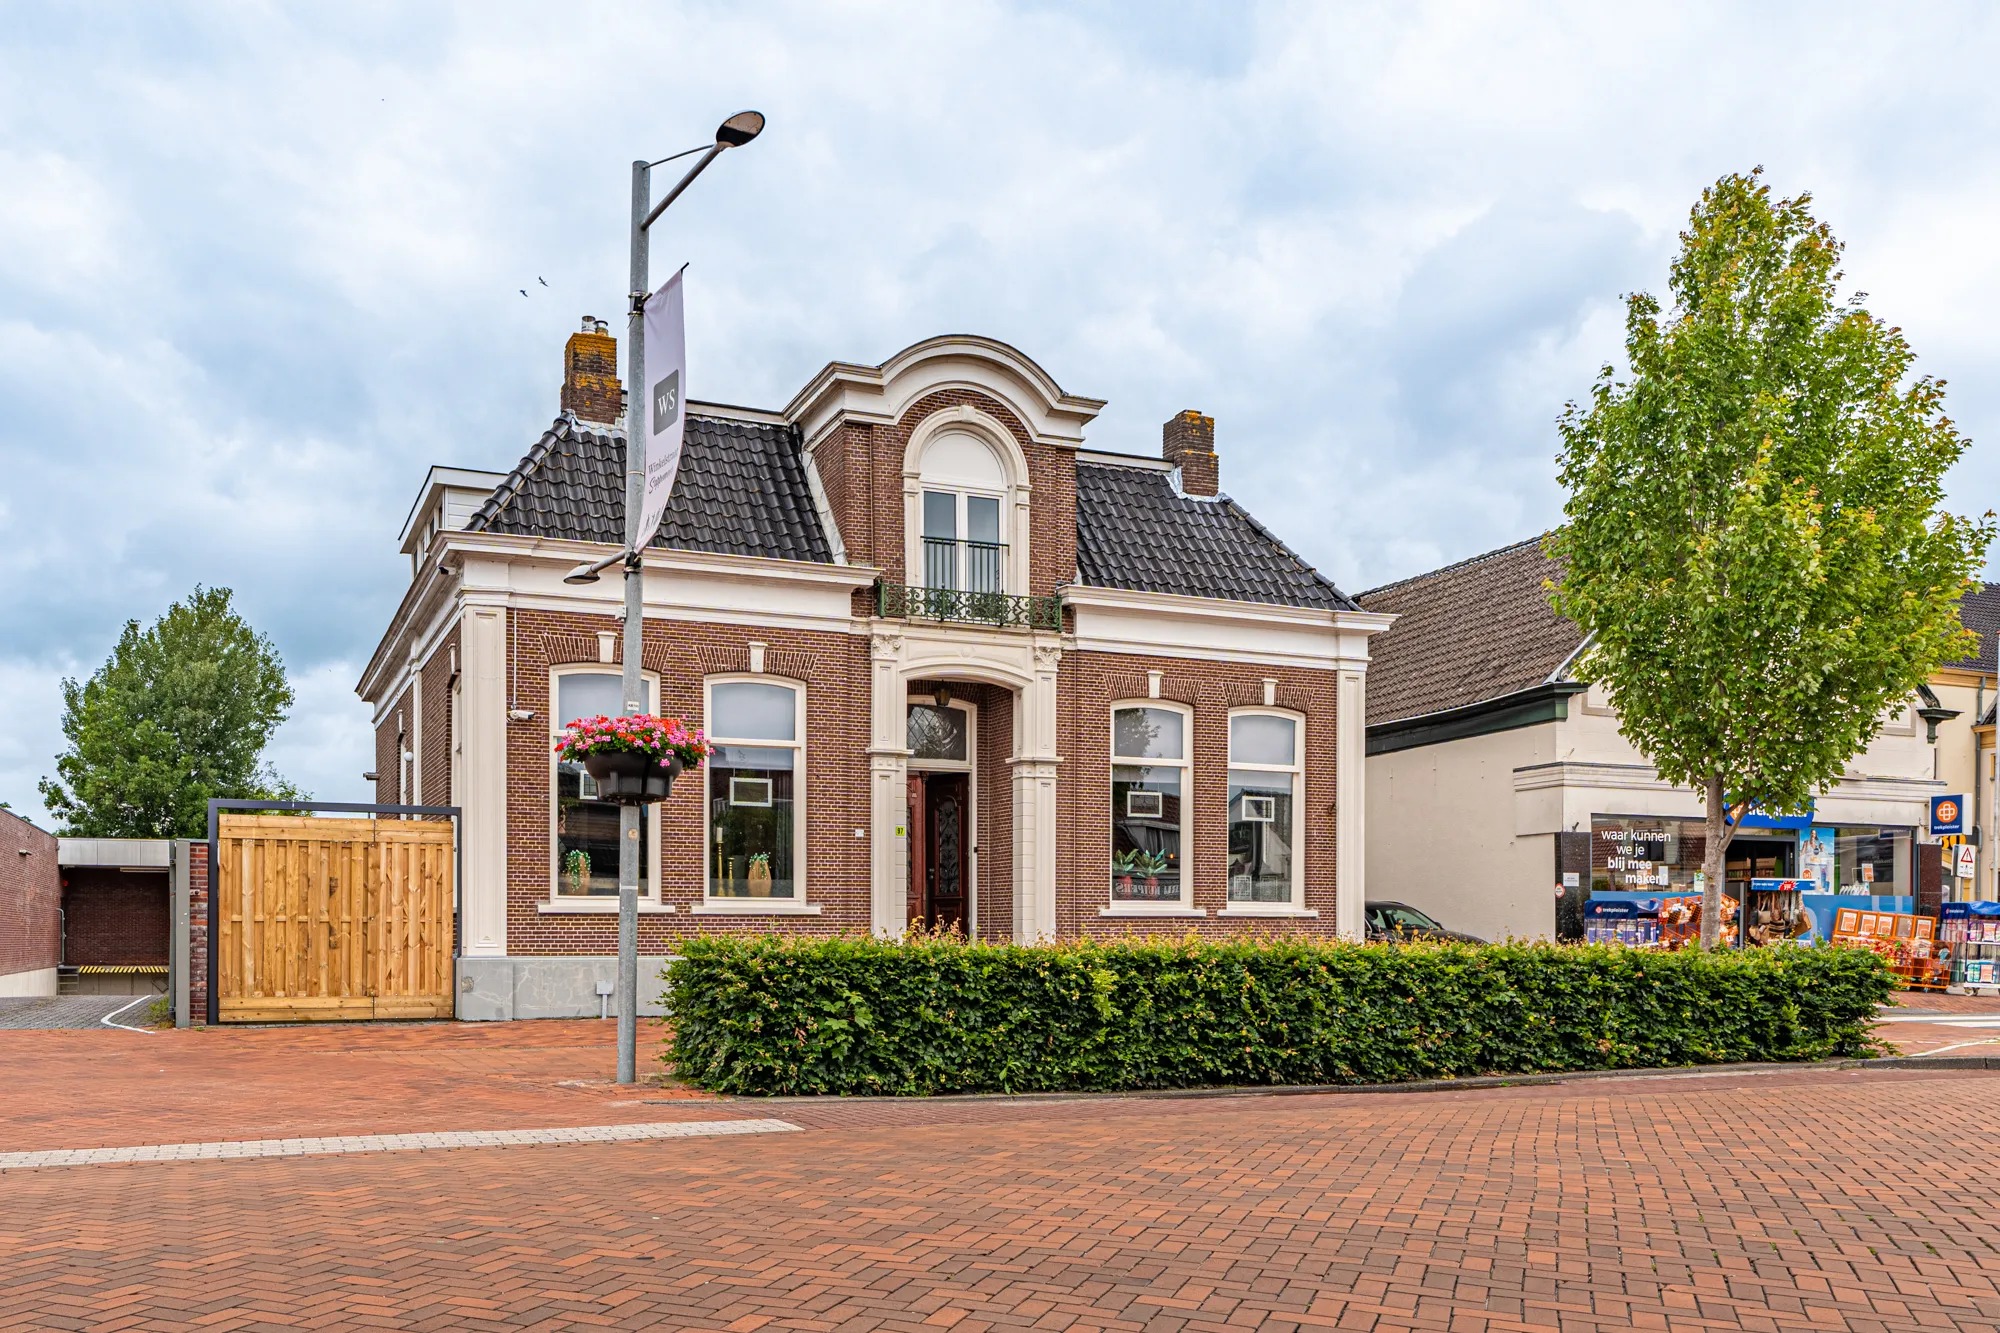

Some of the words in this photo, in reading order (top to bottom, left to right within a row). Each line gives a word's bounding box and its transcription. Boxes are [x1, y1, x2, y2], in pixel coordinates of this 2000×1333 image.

[657, 388, 675, 416] WS
[1601, 830, 1628, 840] waar
[1630, 829, 1671, 842] kunnen
[1616, 845, 1633, 855] we
[1633, 843, 1645, 857] je
[1607, 856, 1626, 871] blij
[1627, 860, 1653, 870] mee
